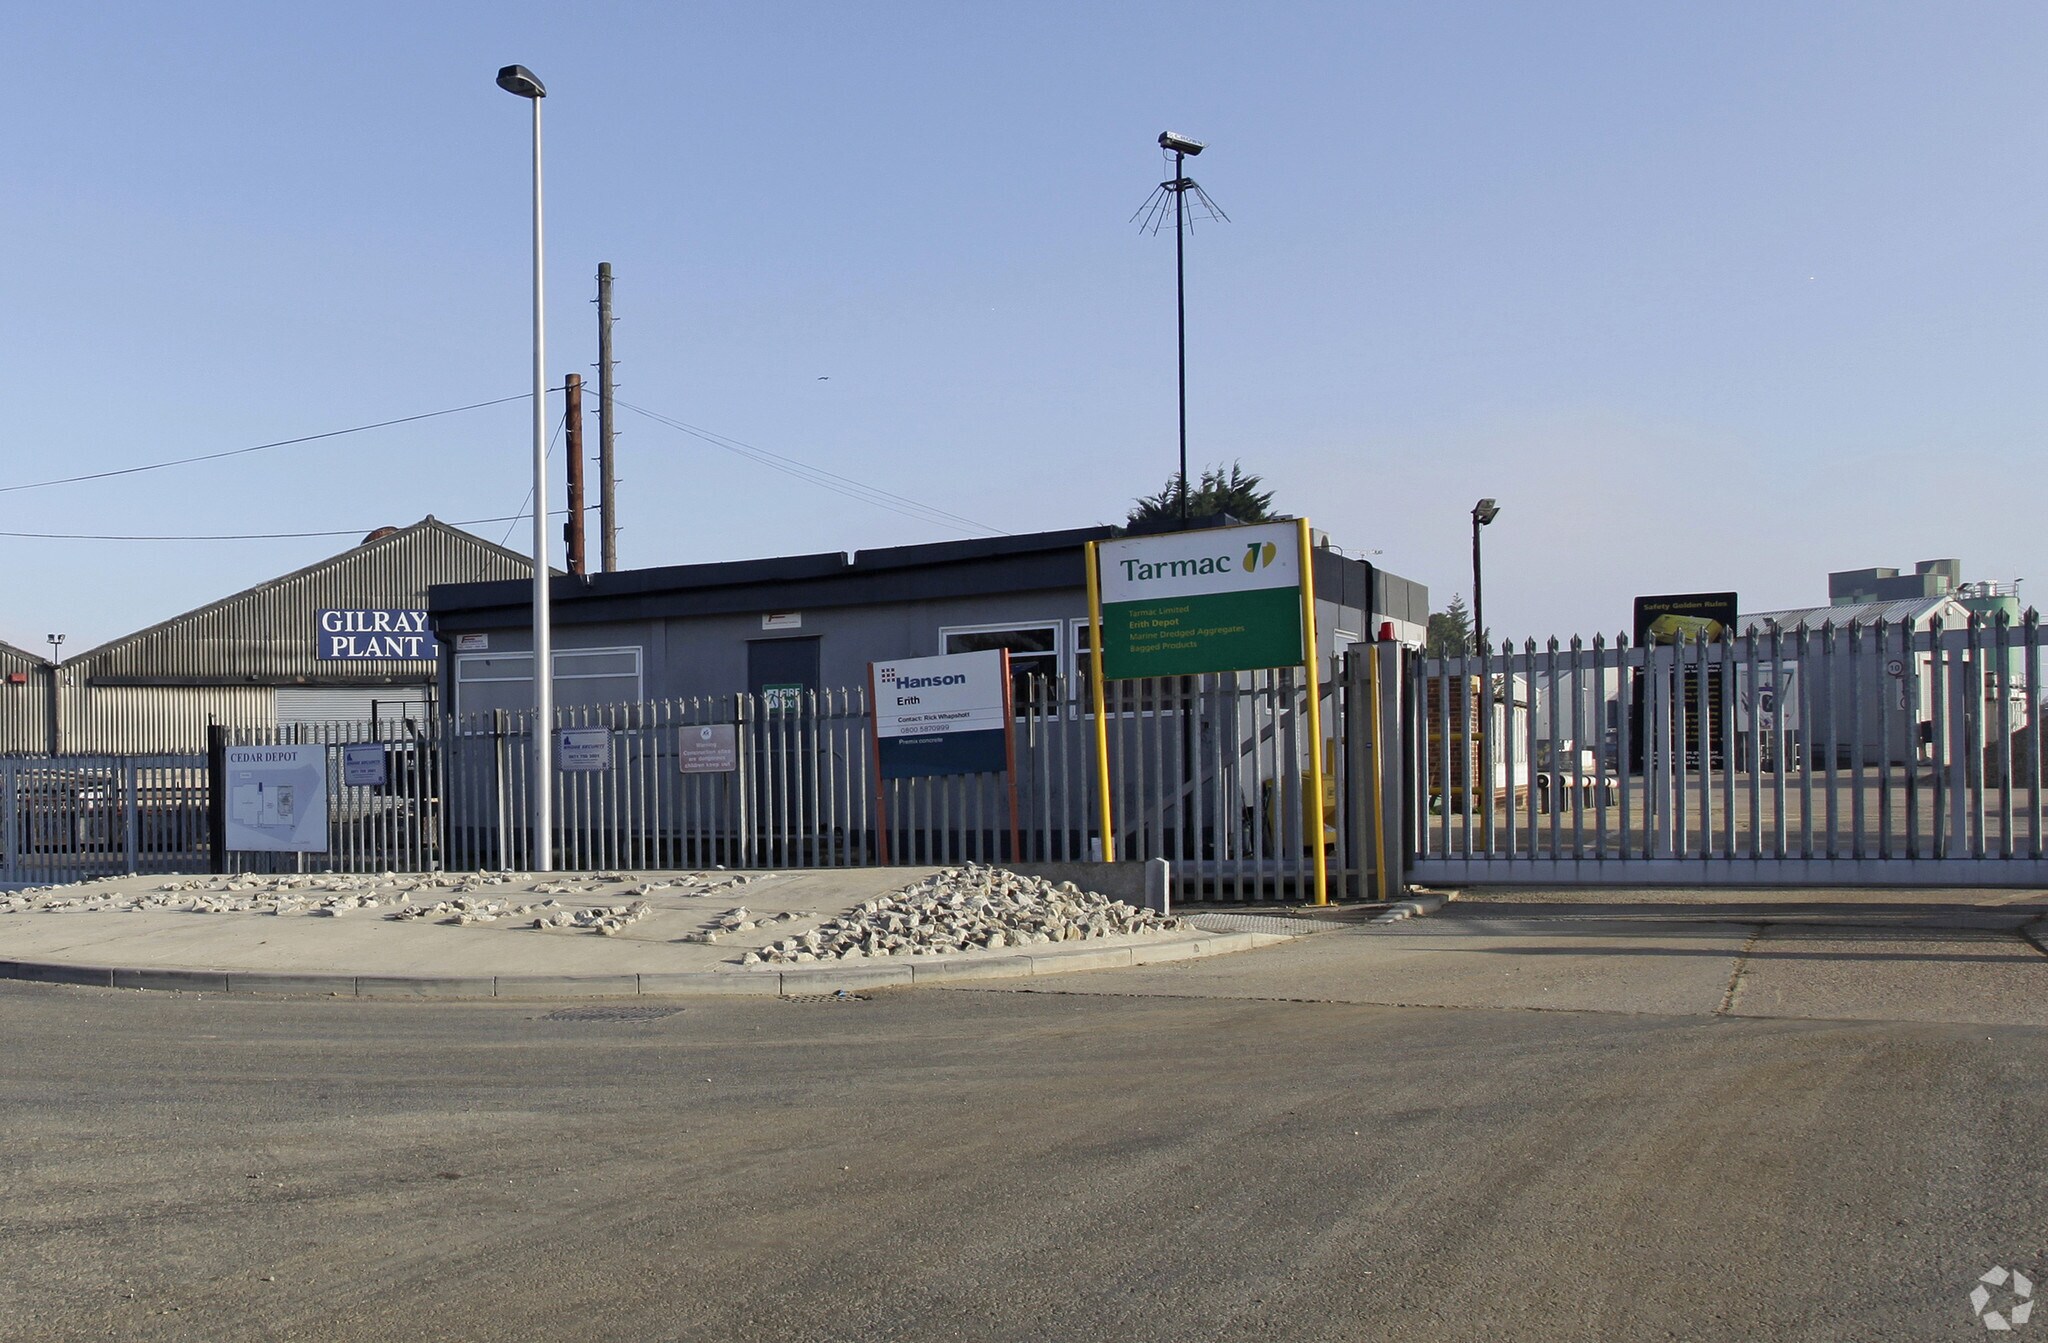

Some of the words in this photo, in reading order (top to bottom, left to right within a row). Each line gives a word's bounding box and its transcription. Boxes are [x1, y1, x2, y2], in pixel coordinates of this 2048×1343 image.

[1120, 556, 1231, 581] Tarmac
[1129, 608, 1158, 618] Tarmac
[1158, 605, 1190, 615] Limited
[322, 610, 428, 632] GILRAY
[1129, 620, 1150, 630] Erith
[1152, 618, 1180, 629] Depot
[1130, 632, 1158, 641] Marine
[1160, 628, 1196, 640] Dredged
[1197, 625, 1246, 637] Aggregates
[331, 636, 424, 658] PLANT
[1130, 644, 1160, 654] Bagged
[1162, 640, 1198, 650] Products
[896, 673, 966, 690] Hanson
[897, 696, 920, 706] Erith
[230, 752, 263, 762] CEDAR
[265, 752, 298, 762] DEPOT
